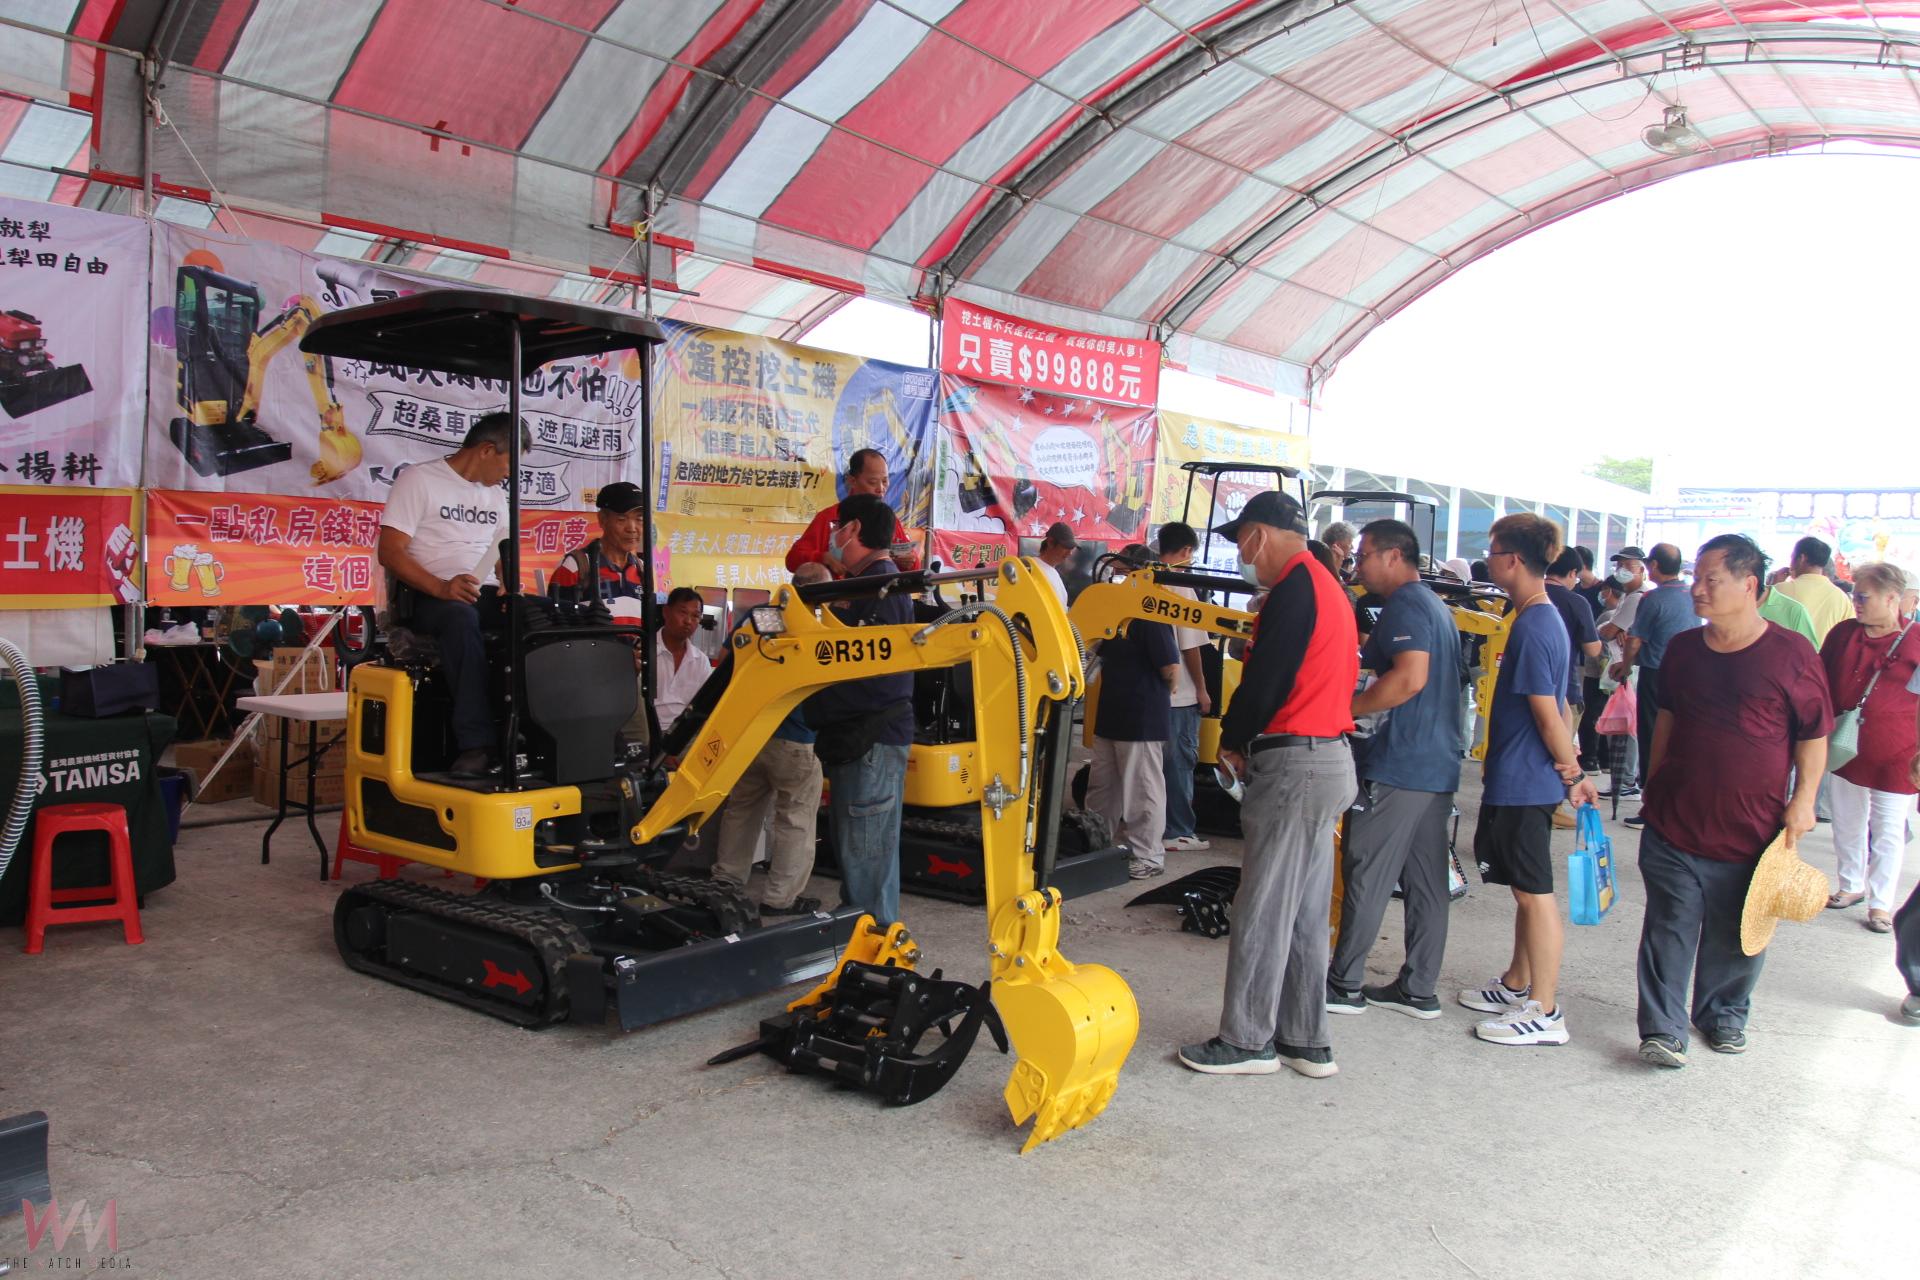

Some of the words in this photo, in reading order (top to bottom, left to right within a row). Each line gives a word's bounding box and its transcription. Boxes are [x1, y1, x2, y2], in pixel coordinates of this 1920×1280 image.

[0, 247, 109, 275] 犁田自由
[537, 417, 622, 452] 遮風避雨
[0, 450, 103, 485] 揚耕
[440, 503, 498, 524] adidas
[3, 515, 86, 573] 土機
[1157, 599, 1202, 624] R319
[835, 637, 892, 663] R319
[49, 760, 141, 793] TAMSA
